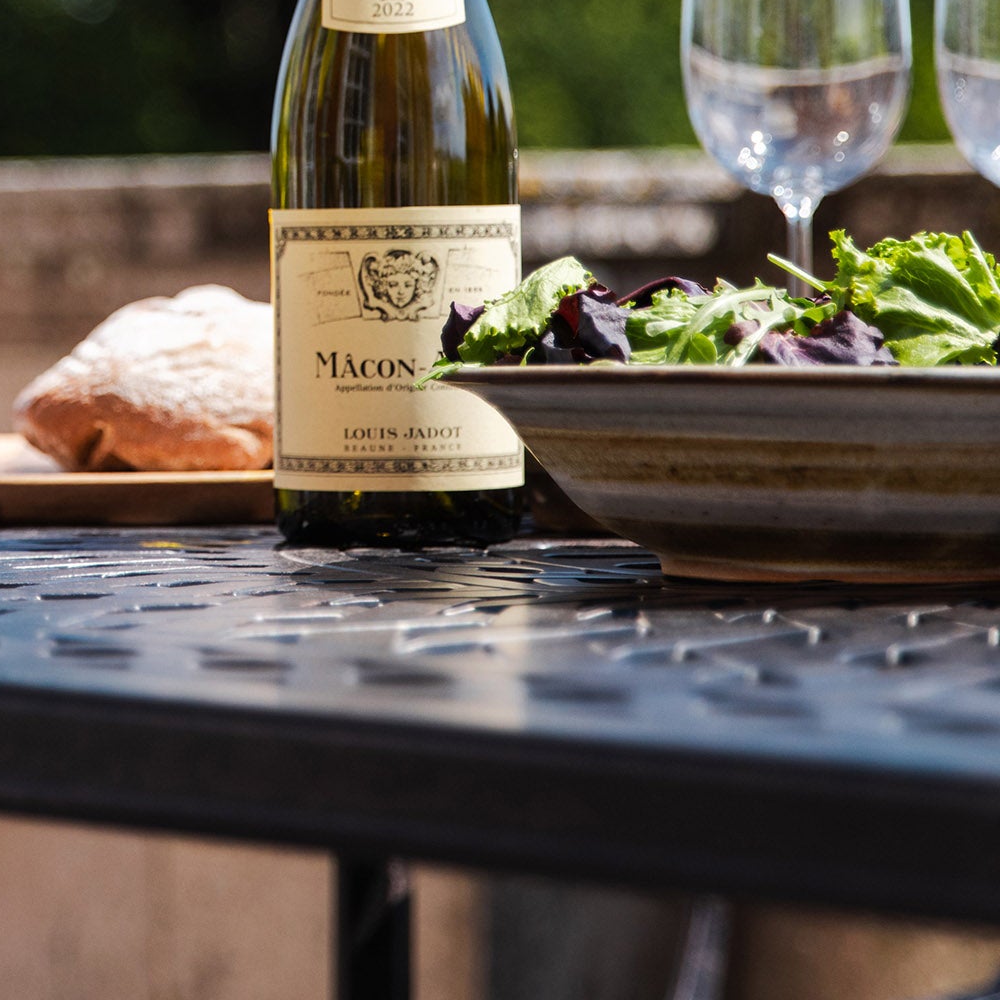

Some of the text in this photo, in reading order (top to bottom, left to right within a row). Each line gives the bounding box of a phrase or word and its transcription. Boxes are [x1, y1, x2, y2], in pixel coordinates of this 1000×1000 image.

[372, 2, 415, 18] 2022
[344, 426, 462, 440] LOUIS JADOT
[344, 444, 393, 453] BEAUNE
[413, 443, 462, 453] FRANCE
